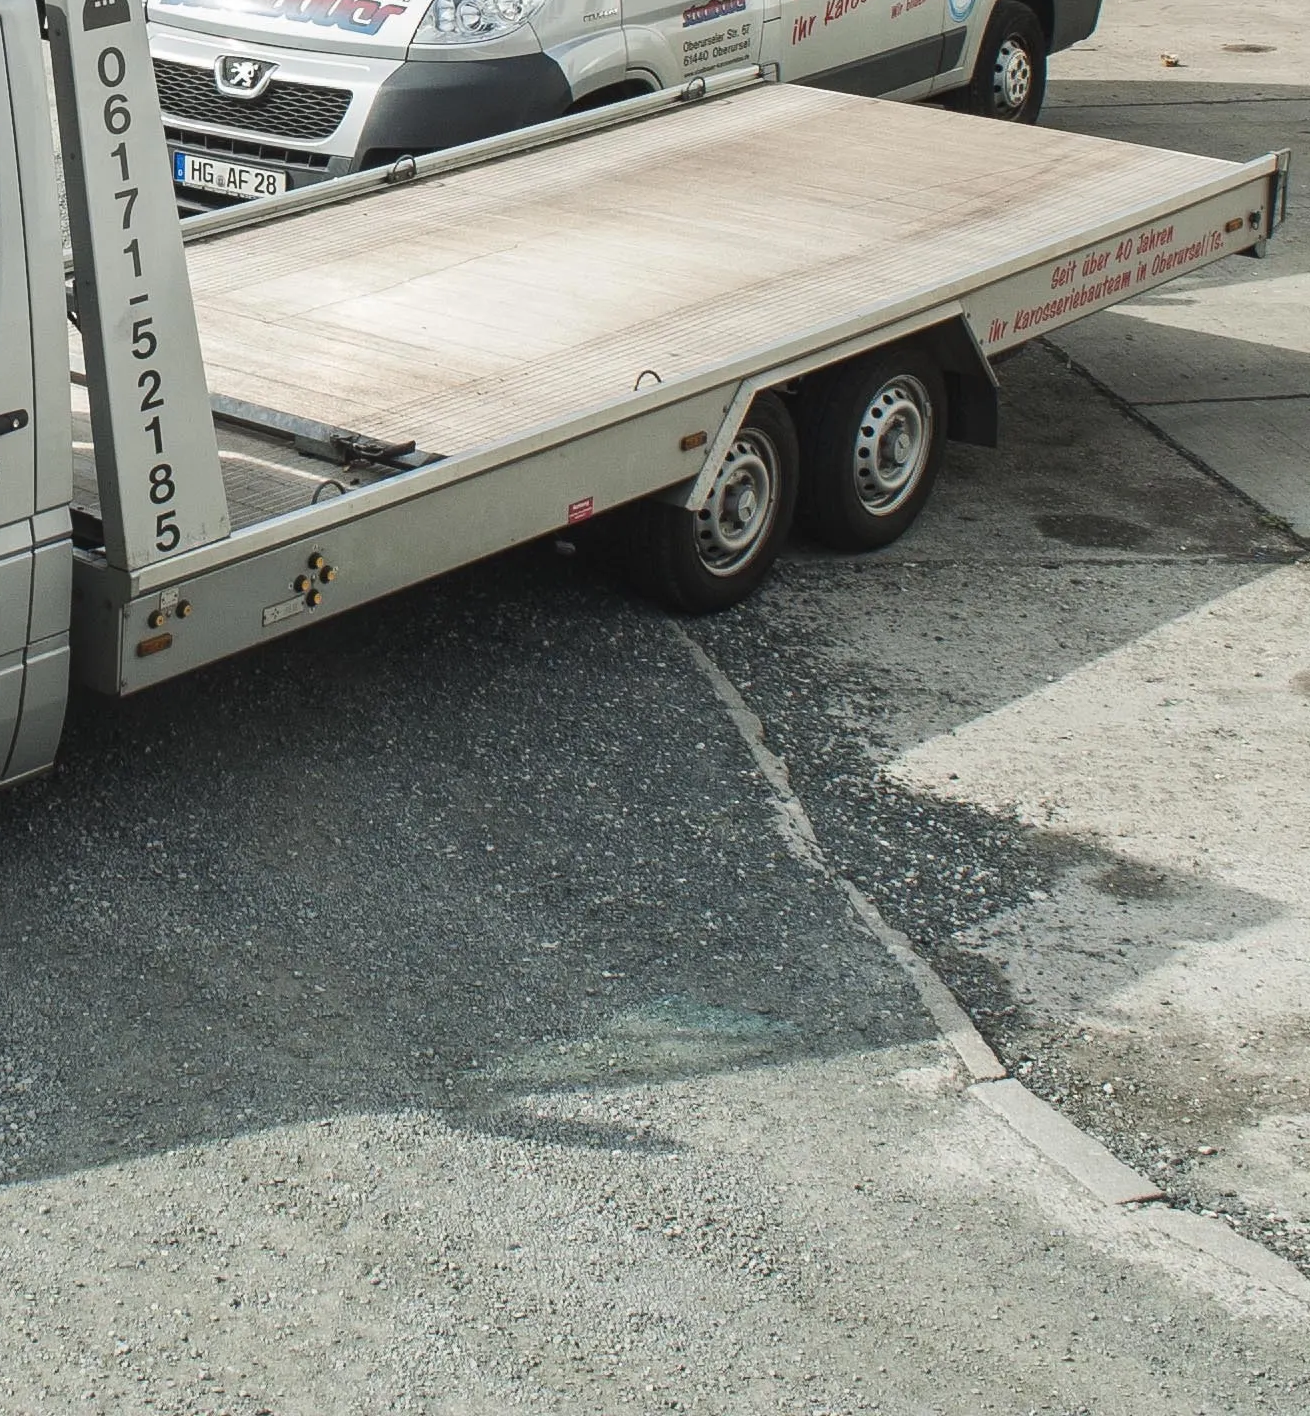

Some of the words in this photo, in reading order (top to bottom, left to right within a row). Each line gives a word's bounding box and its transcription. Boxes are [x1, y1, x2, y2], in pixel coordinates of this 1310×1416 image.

[191, 160, 214, 184] HG
[227, 167, 250, 190] AF
[254, 172, 277, 196] 28
[1081, 251, 1111, 277] über
[1115, 238, 1132, 262] 40
[1136, 225, 1174, 253] Jahren
[1014, 270, 1131, 332] Karosseriebauteam
[1136, 261, 1147, 283] in
